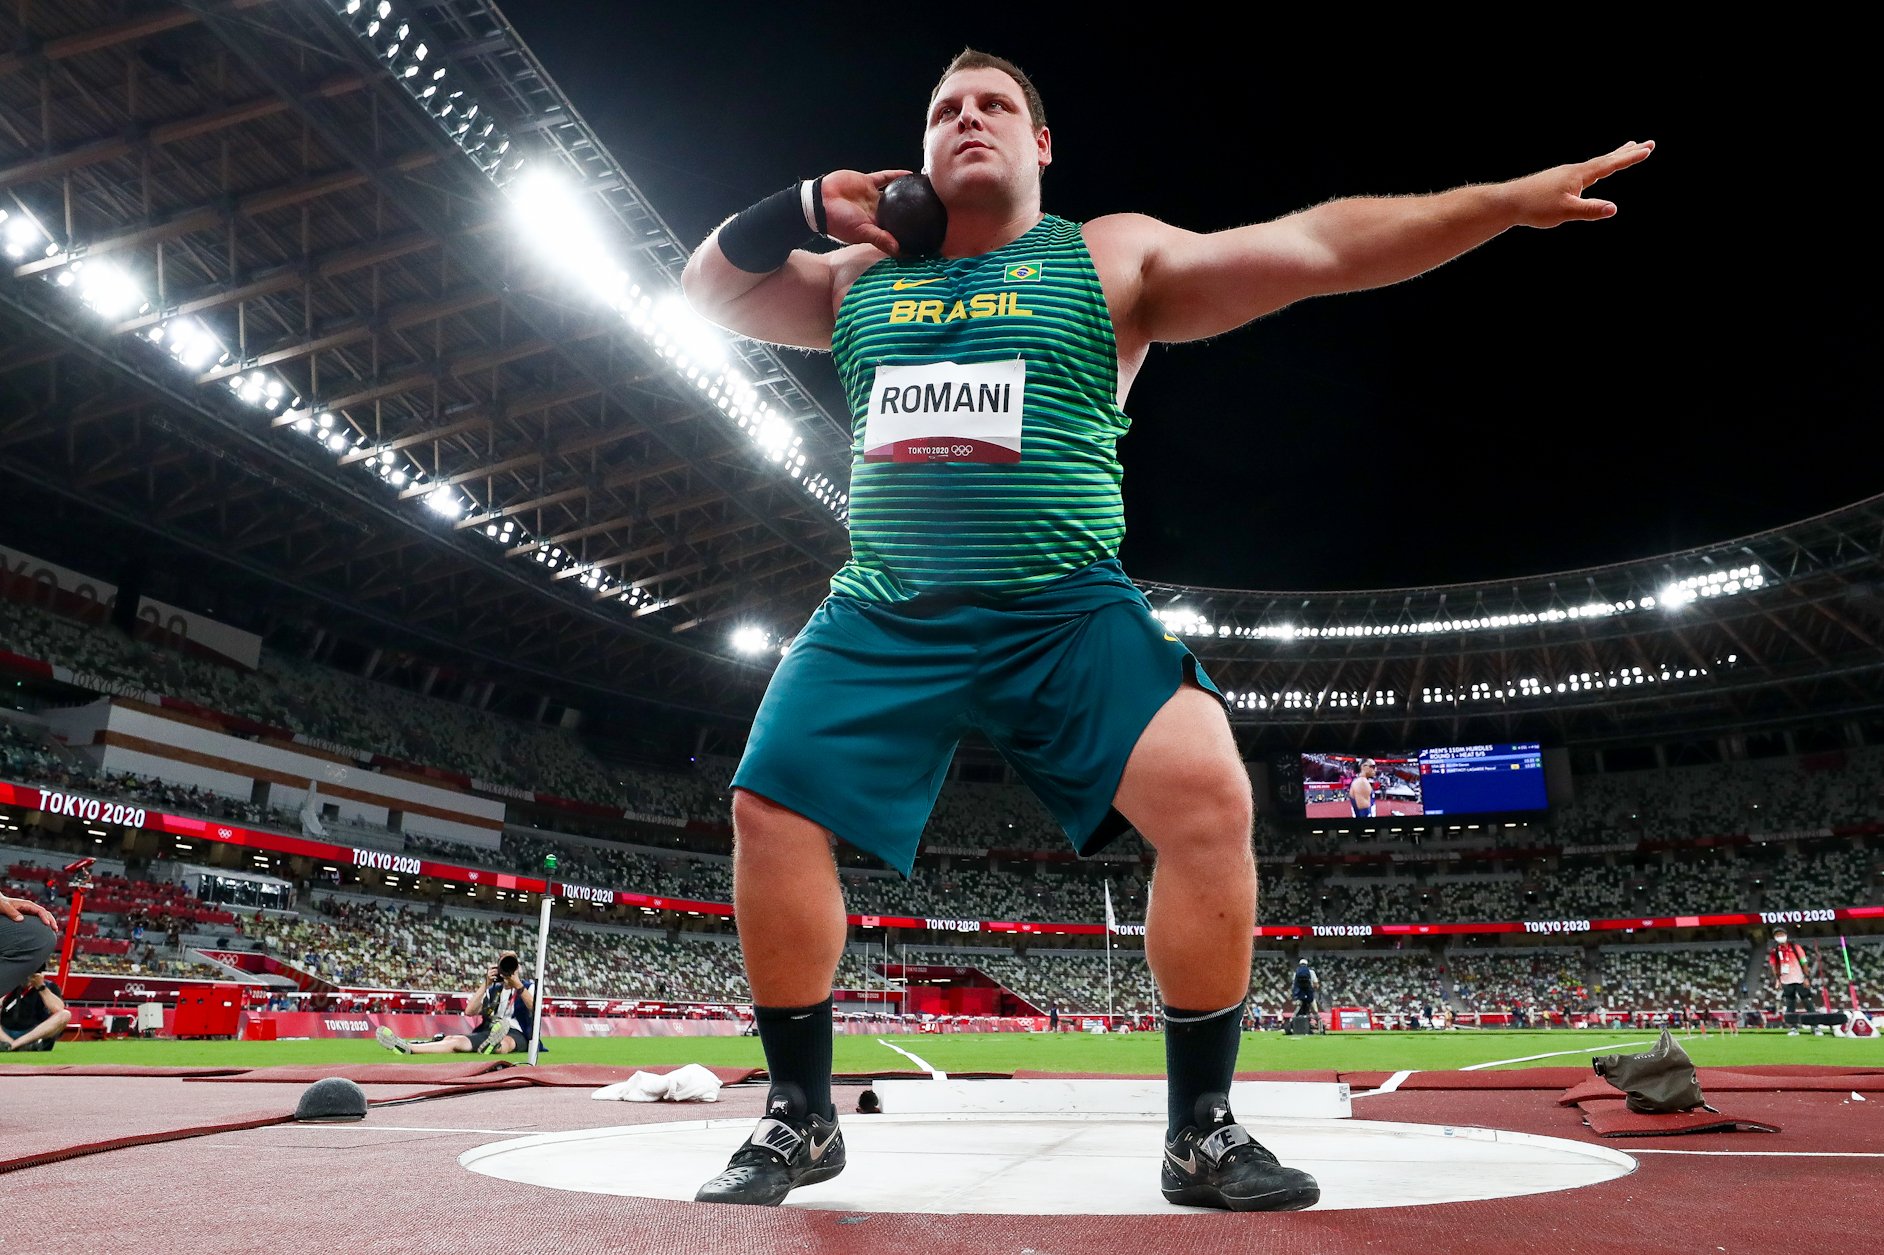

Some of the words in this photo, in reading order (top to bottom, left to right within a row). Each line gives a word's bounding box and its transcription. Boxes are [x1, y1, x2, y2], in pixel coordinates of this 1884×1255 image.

[889, 292, 1033, 323] BRASIL
[880, 382, 1011, 415] ROMANI
[908, 447, 931, 455] TOKYO
[931, 447, 949, 455] 2020
[39, 790, 100, 820] TOKYO
[101, 803, 145, 828] 2020
[353, 848, 391, 870] TOKYO
[392, 856, 421, 875] 2020
[562, 884, 590, 900] TOKYO
[591, 888, 613, 903] 2020
[1759, 911, 1802, 924] TOKYO
[1803, 909, 1835, 922] 2020
[925, 919, 956, 930] TOKYO
[956, 921, 980, 931] 2020
[1116, 925, 1146, 935] TOKYO
[1312, 925, 1345, 936] TOKYO
[1346, 925, 1372, 936] 2020
[1524, 921, 1561, 932] TOKYO
[1562, 920, 1590, 931] 2020
[324, 1020, 349, 1031] TOKYO
[350, 1021, 368, 1031] 2020
